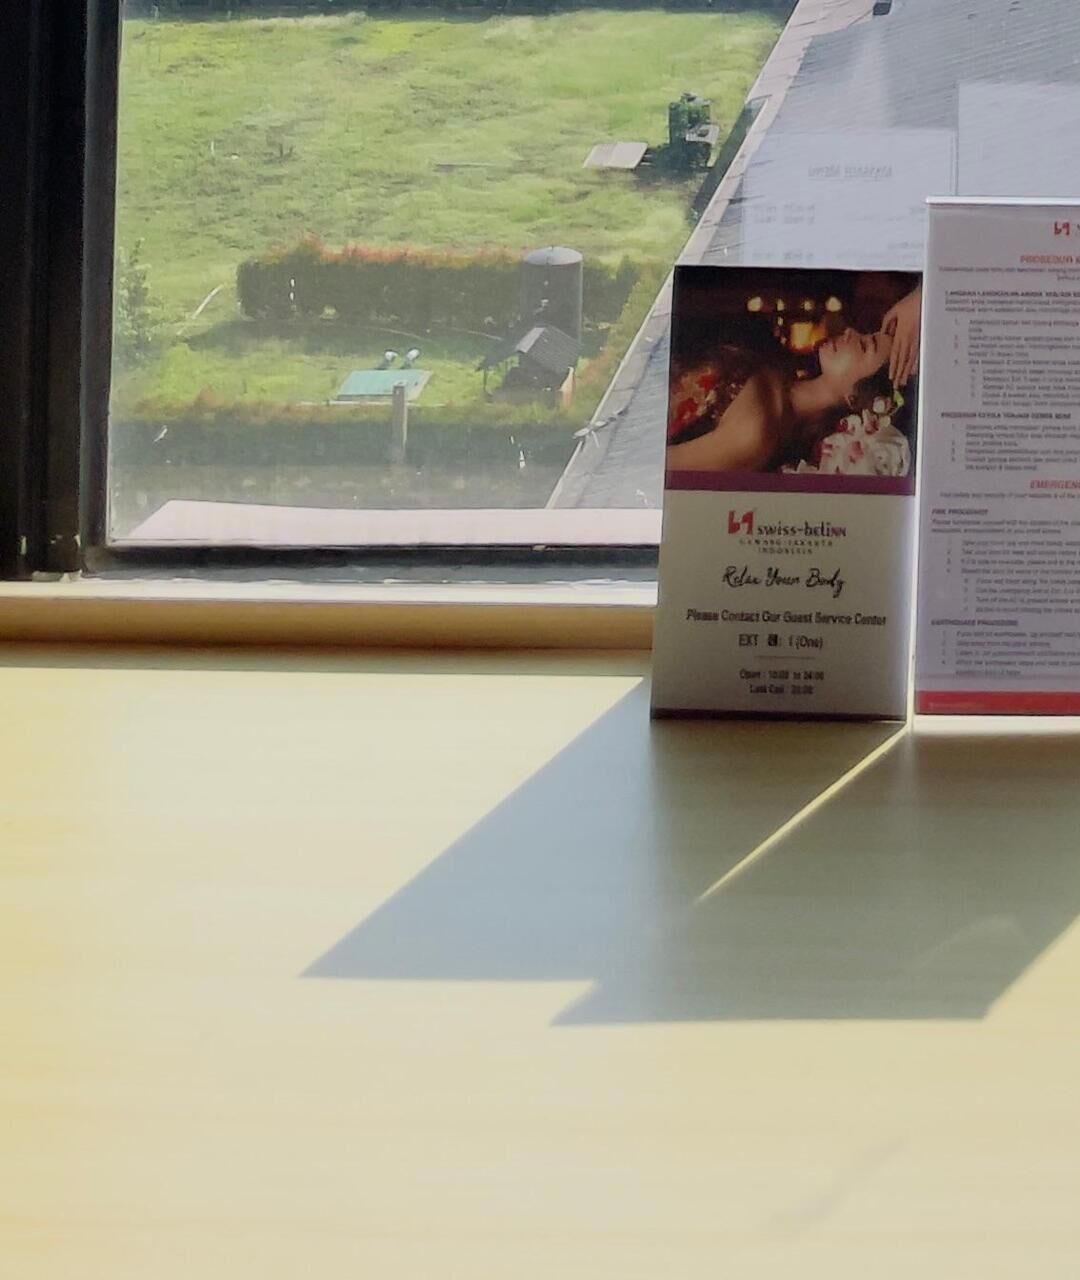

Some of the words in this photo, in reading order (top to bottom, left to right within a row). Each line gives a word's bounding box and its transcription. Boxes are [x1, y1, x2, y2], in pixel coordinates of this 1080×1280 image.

[722, 565, 761, 588] Relax
[765, 566, 800, 587] Your
[805, 567, 847, 599] Body
[686, 608, 719, 621] Please
[721, 609, 760, 622] Contact
[762, 610, 780, 622] Our
[783, 611, 813, 624] Guest
[815, 611, 852, 624] Service
[855, 612, 887, 626] Center
[738, 634, 759, 647] EXT
[795, 634, 824, 650] (One)
[739, 669, 761, 679] Open
